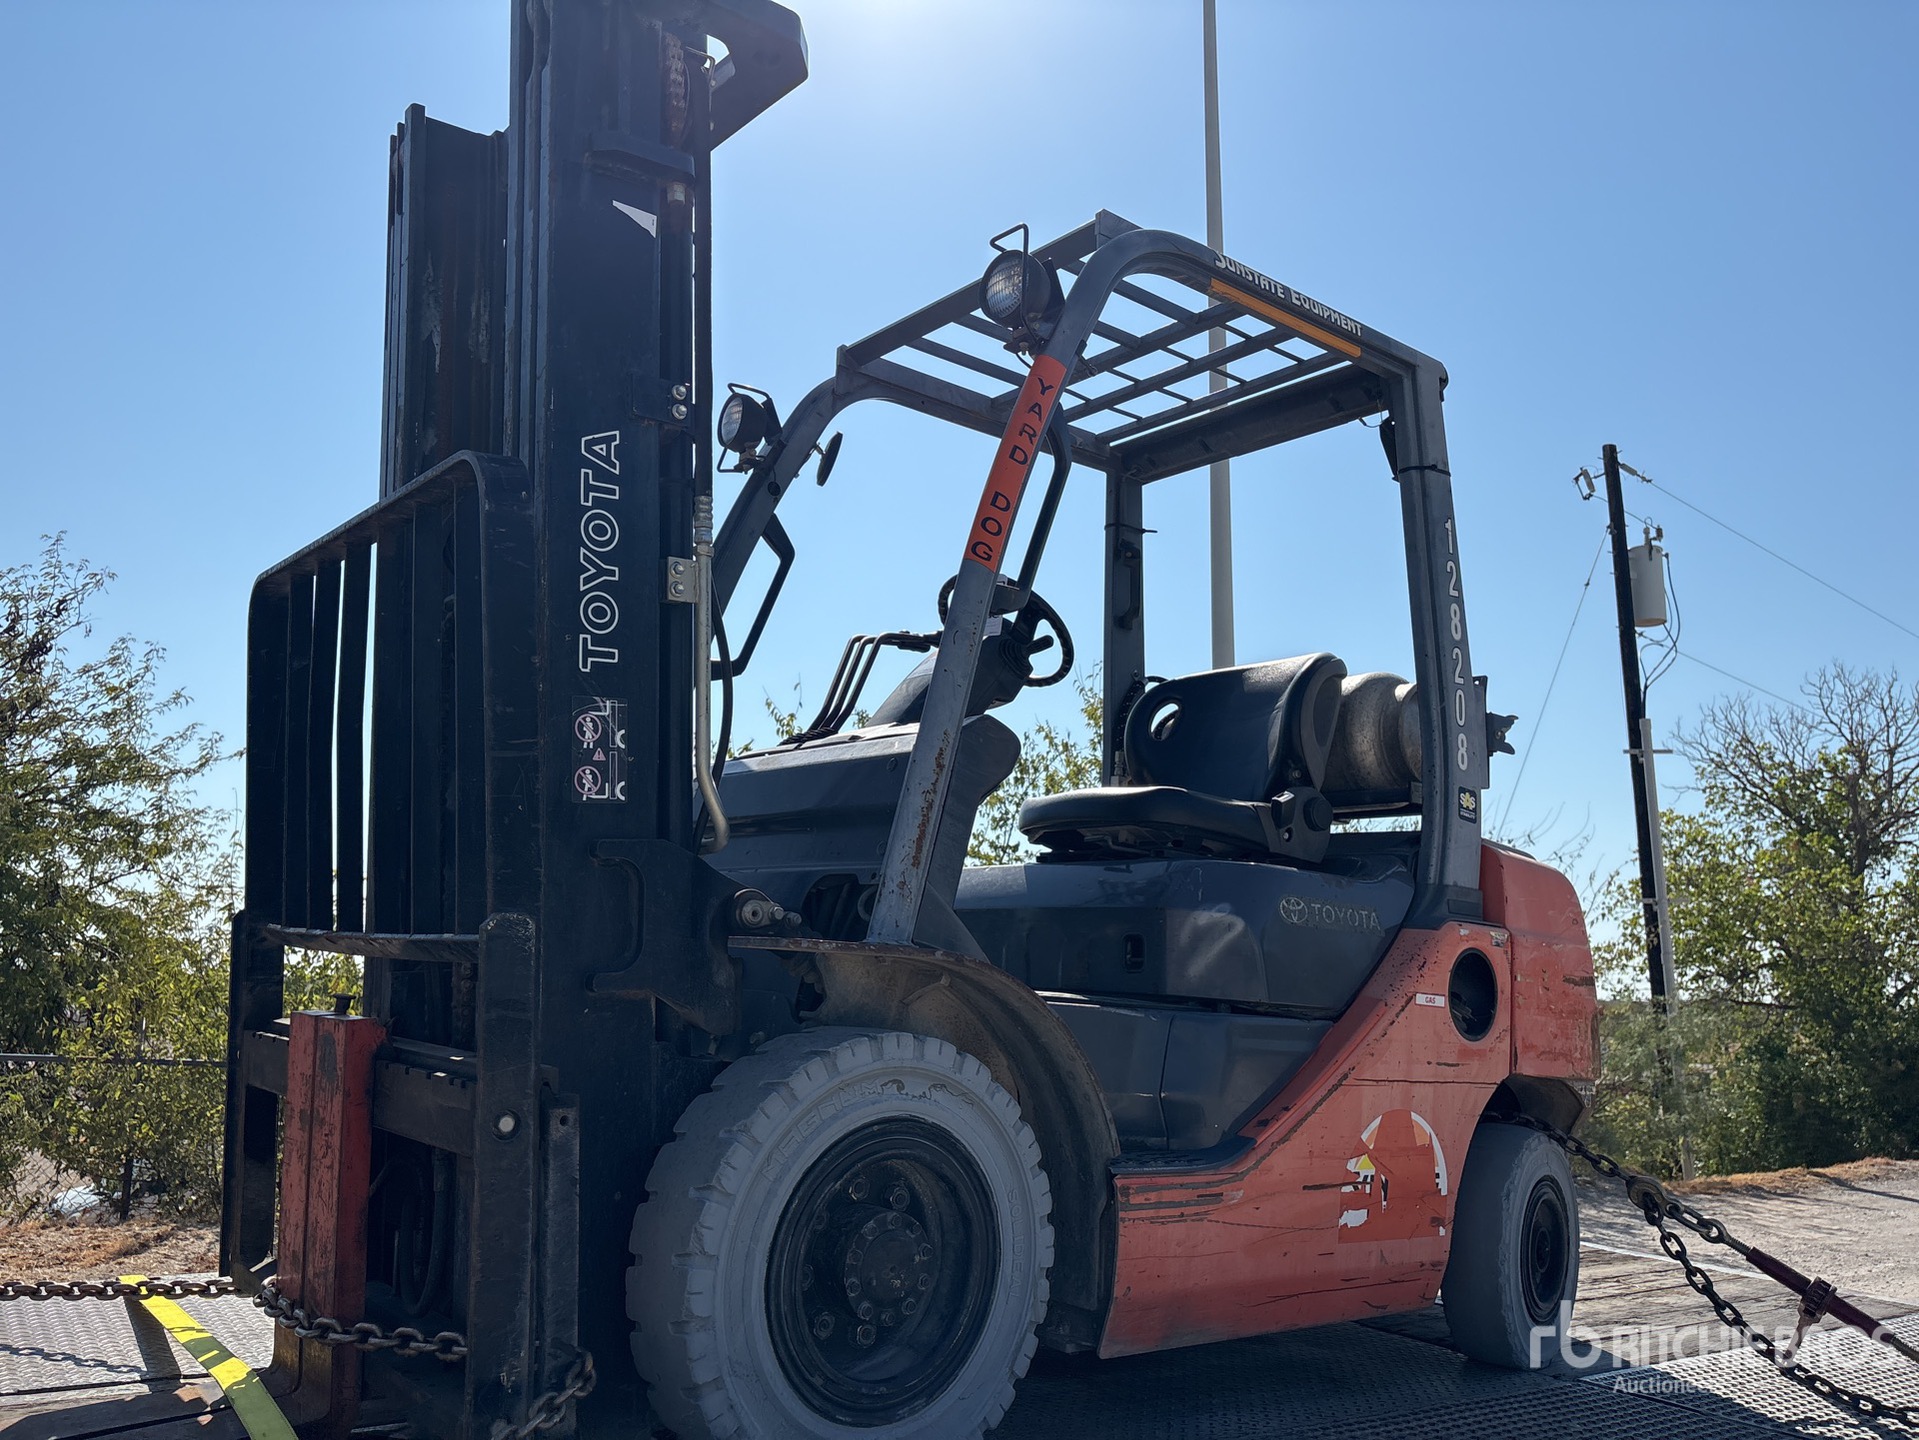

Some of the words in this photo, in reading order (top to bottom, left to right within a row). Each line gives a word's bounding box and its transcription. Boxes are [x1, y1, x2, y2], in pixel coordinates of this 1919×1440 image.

[1215, 251, 1285, 299] SUNSTATE
[1291, 288, 1362, 337] EQUIPMENT
[1009, 377, 1054, 466] YARD
[578, 430, 620, 673] TOYOTA
[971, 491, 1011, 562] DOG
[1444, 518, 1469, 771] 128208
[1311, 903, 1381, 931] TOYOTA
[1006, 1189, 1024, 1305] SOLIDEAL
